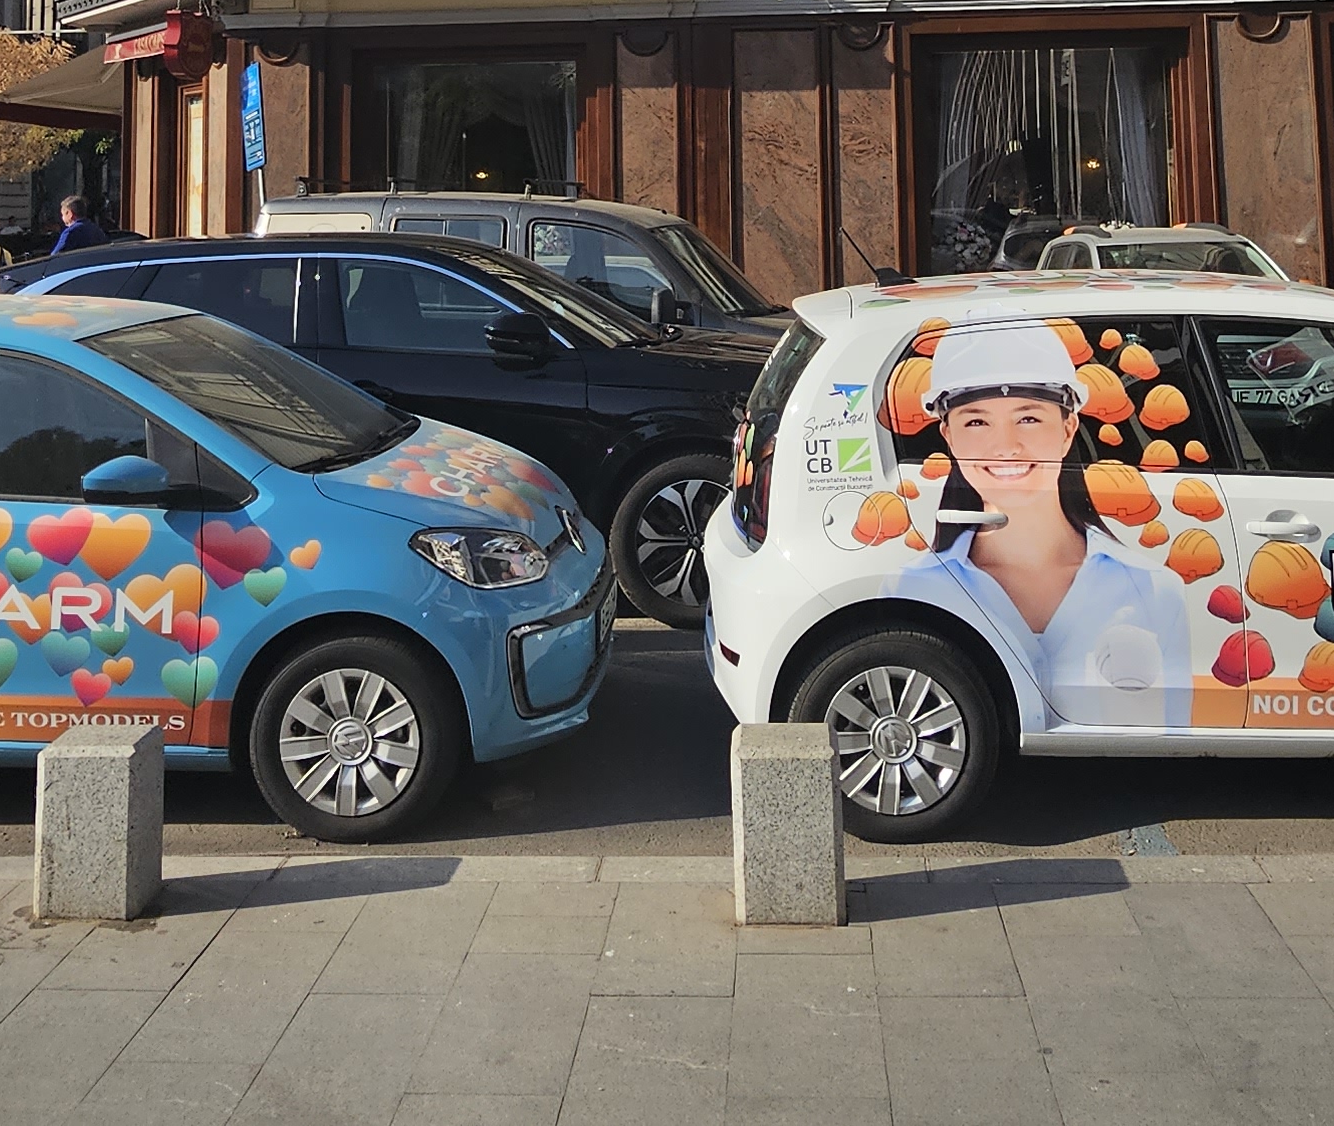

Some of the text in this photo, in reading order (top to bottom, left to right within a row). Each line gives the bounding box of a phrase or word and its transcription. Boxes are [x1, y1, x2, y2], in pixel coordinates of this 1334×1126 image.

[805, 439, 832, 455] UT
[806, 457, 833, 474] CB
[1253, 695, 1299, 715] NOI
[11, 712, 185, 731] TOPMODELS
